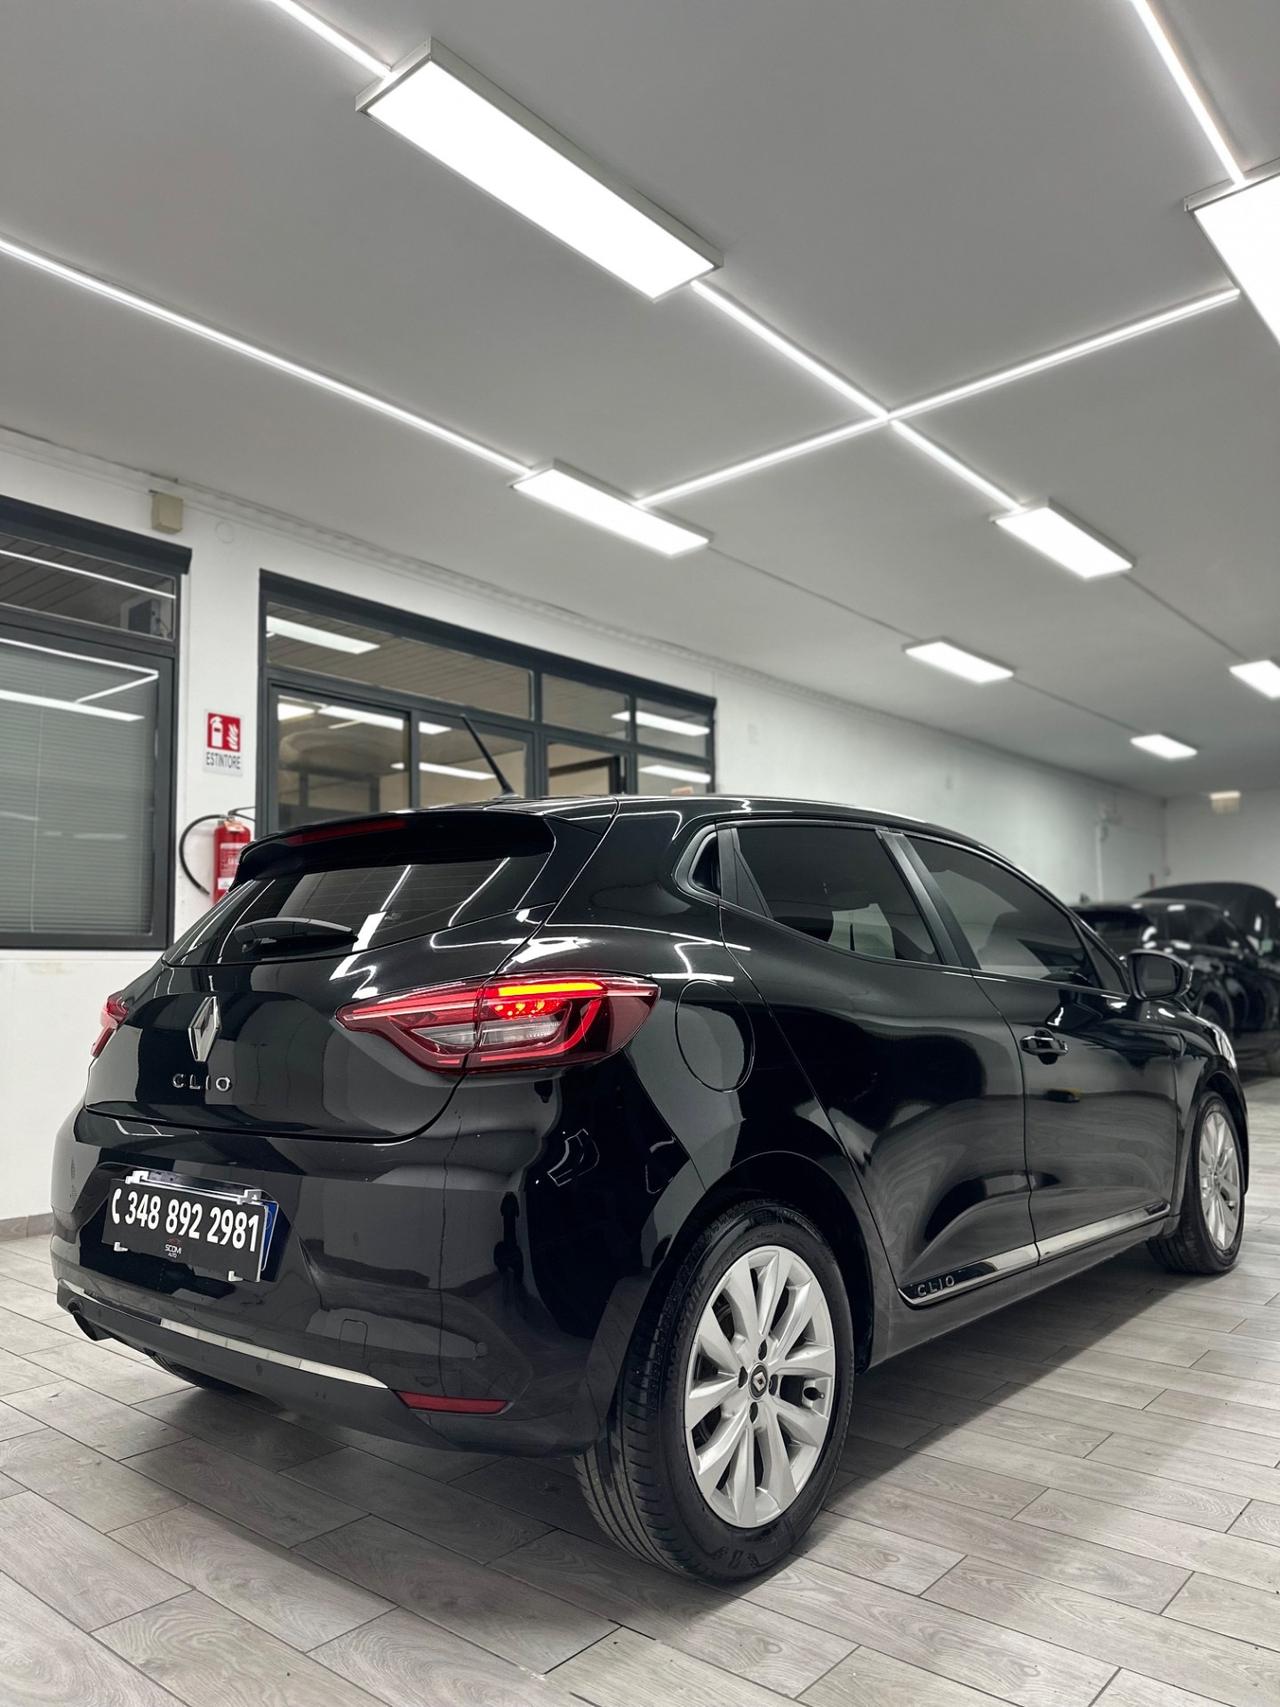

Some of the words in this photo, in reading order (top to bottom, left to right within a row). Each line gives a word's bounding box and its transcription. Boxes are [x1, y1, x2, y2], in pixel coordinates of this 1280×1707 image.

[206, 752, 241, 770] ESTINTORE
[173, 1073, 231, 1092] CLIO
[125, 1191, 162, 1230] 348
[165, 1199, 203, 1240] 892
[206, 1207, 259, 1252] 2981
[917, 1275, 955, 1296] CLIO
